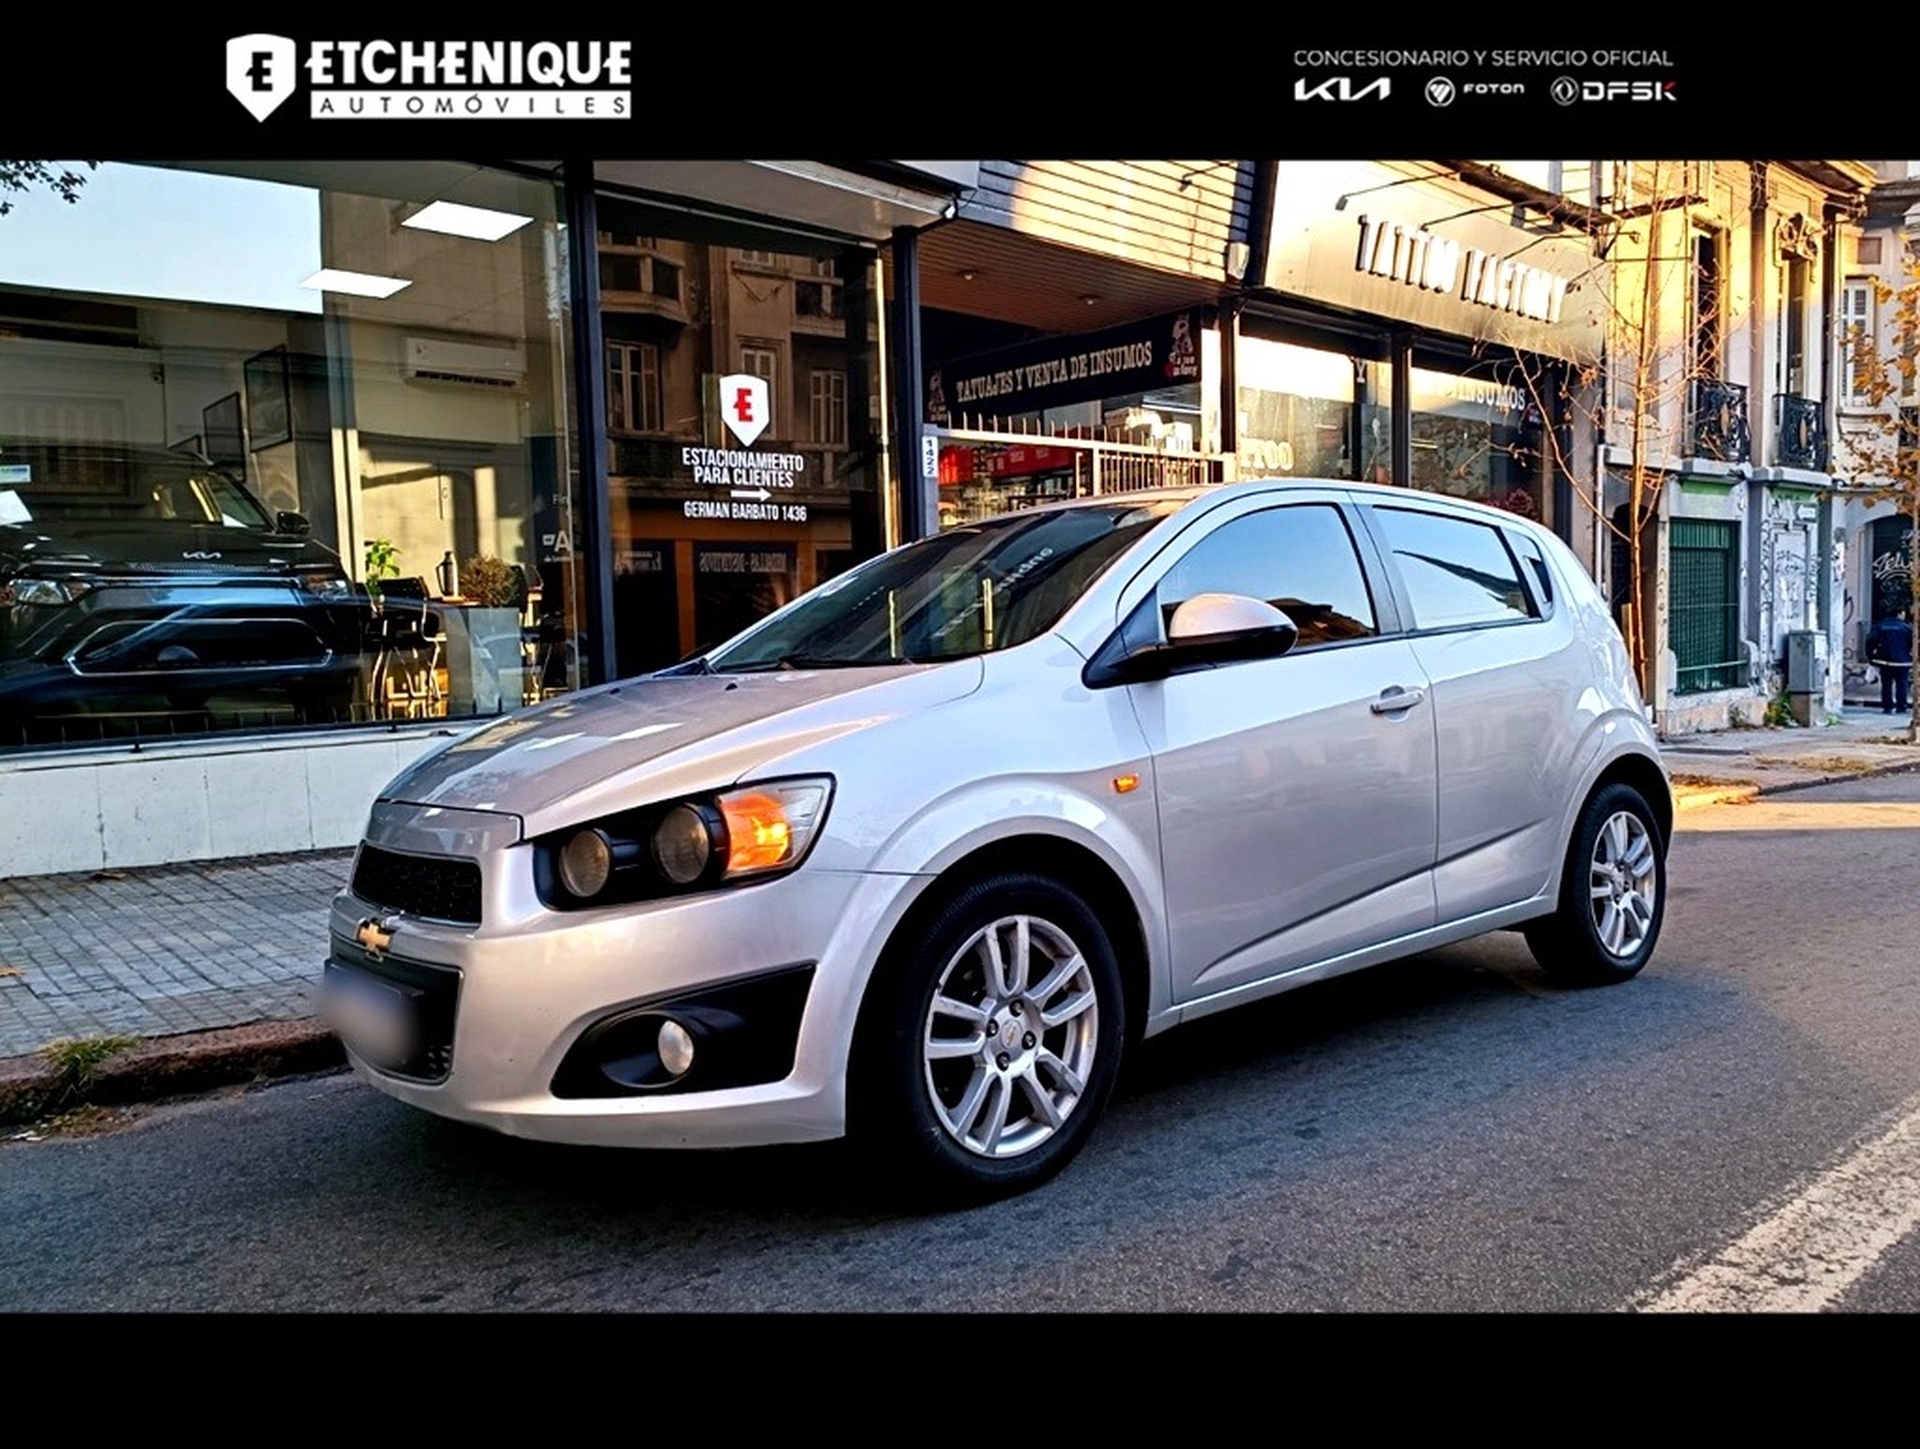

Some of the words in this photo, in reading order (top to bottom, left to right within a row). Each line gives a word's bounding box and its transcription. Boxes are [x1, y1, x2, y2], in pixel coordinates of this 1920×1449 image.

[956, 371, 1015, 403] TATUAJES
[1015, 367, 1024, 391] Y
[1025, 358, 1069, 388] VENTA
[1070, 353, 1088, 380] DE
[1090, 341, 1152, 376] INSUMOS
[682, 447, 804, 471] ESTACIONAMIENTO
[694, 466, 731, 485] PARA
[733, 468, 795, 488] CLIENTES
[684, 501, 730, 519] GERMAN
[731, 502, 779, 520] BARBATO
[781, 505, 808, 521] 1436
